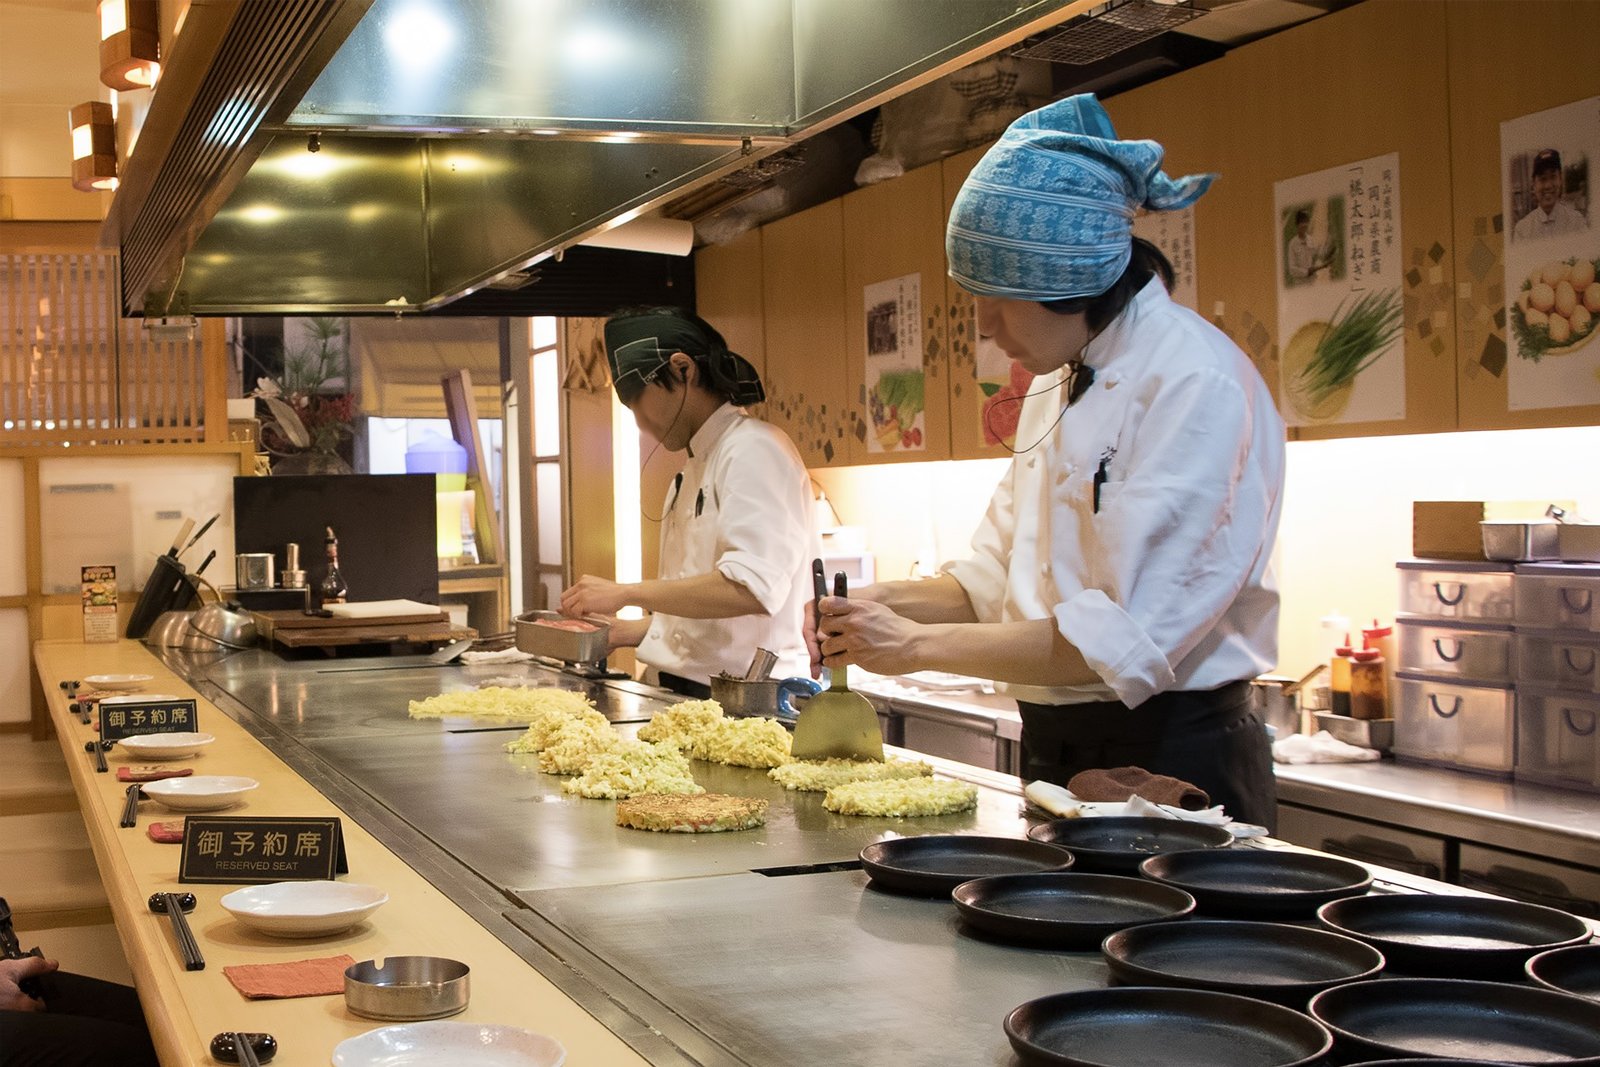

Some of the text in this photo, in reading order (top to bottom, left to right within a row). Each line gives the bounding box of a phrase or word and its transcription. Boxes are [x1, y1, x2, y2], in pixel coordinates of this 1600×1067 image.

[1348, 166, 1365, 292] 「桃太郎ねぎ」
[109, 707, 188, 728] 御予約席
[122, 726, 158, 735] RESERVED
[198, 831, 322, 858] 御予約席
[216, 861, 299, 870] RESERVED SEAT
